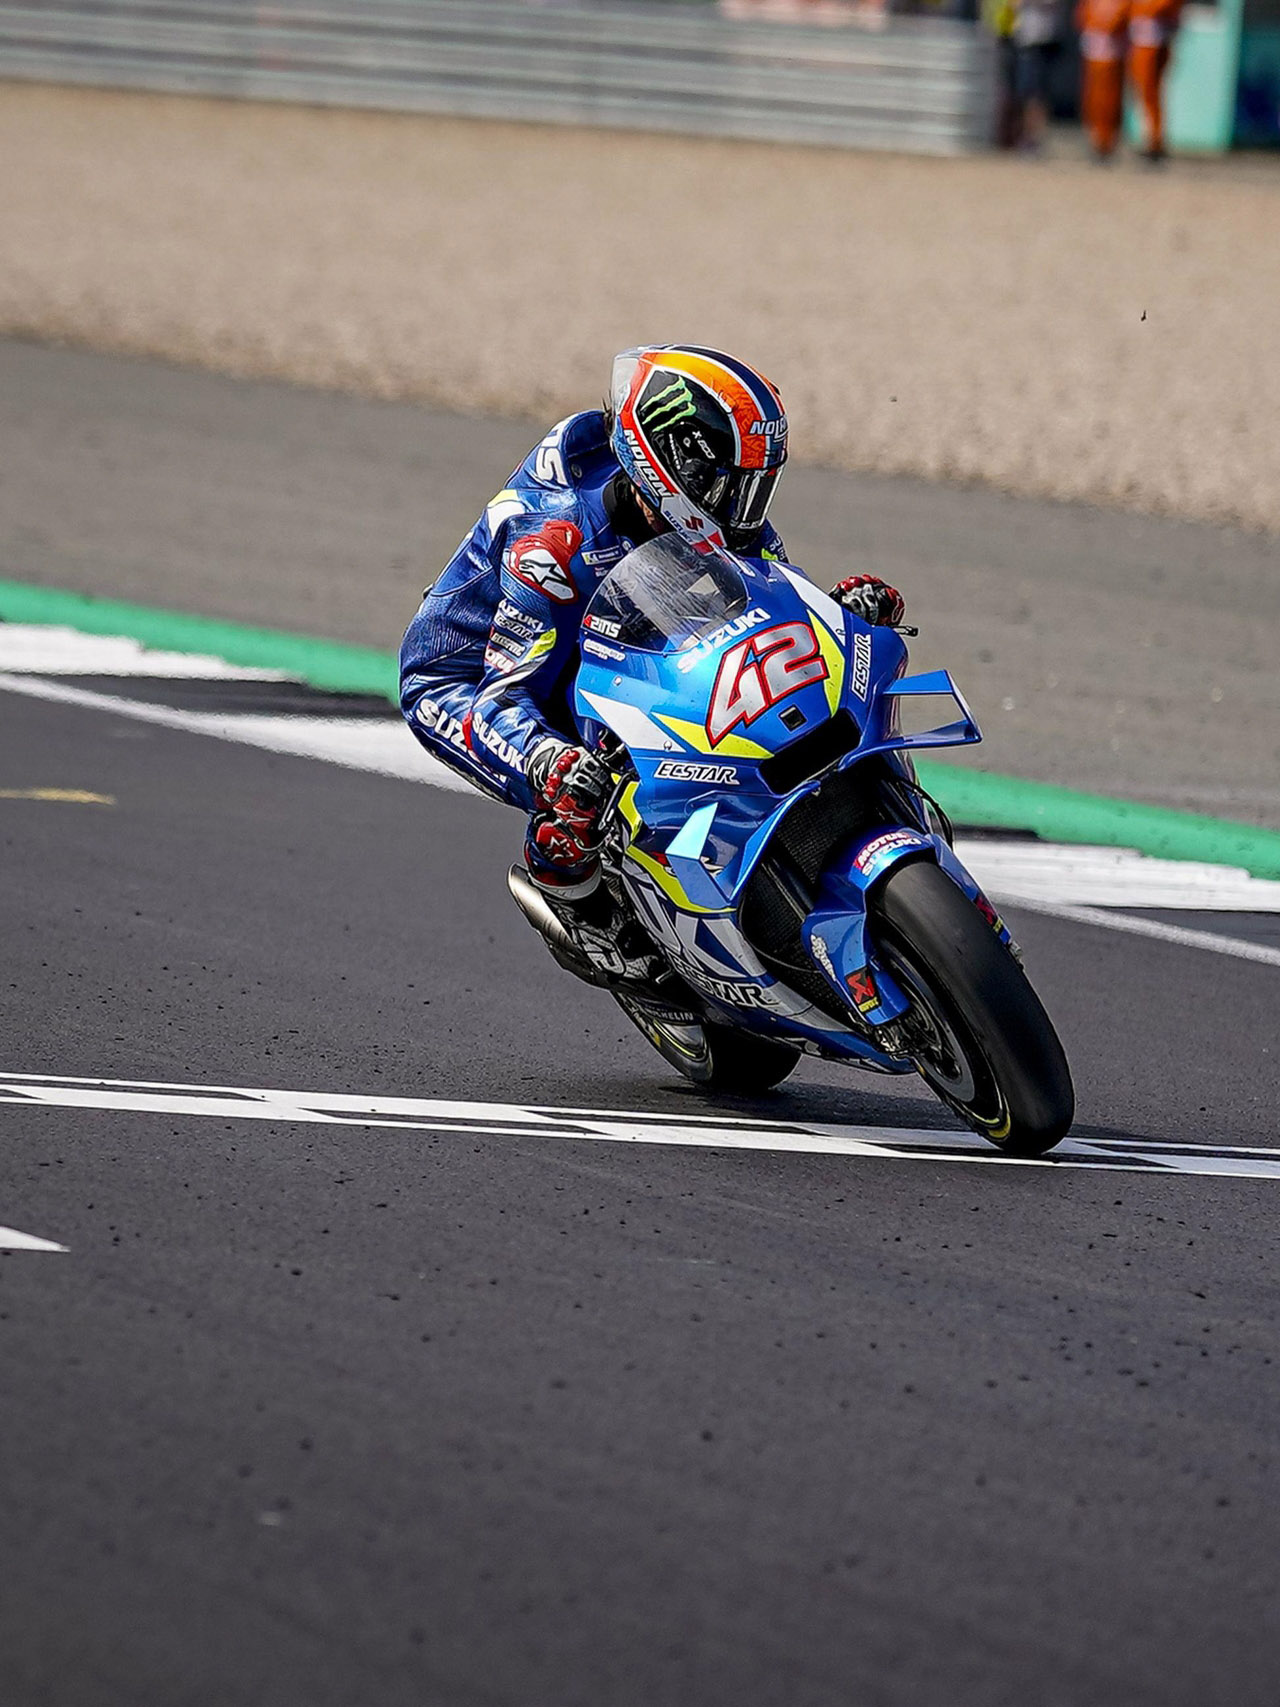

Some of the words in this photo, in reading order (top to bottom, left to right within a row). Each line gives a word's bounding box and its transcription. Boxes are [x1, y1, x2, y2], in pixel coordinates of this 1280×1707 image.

[623, 429, 673, 497] NOLAN
[677, 607, 771, 674] SUZUKI
[852, 633, 871, 702] ECSTAR
[705, 620, 830, 750] 42
[655, 761, 740, 785] ECSTAR
[857, 831, 909, 867] MOTUL
